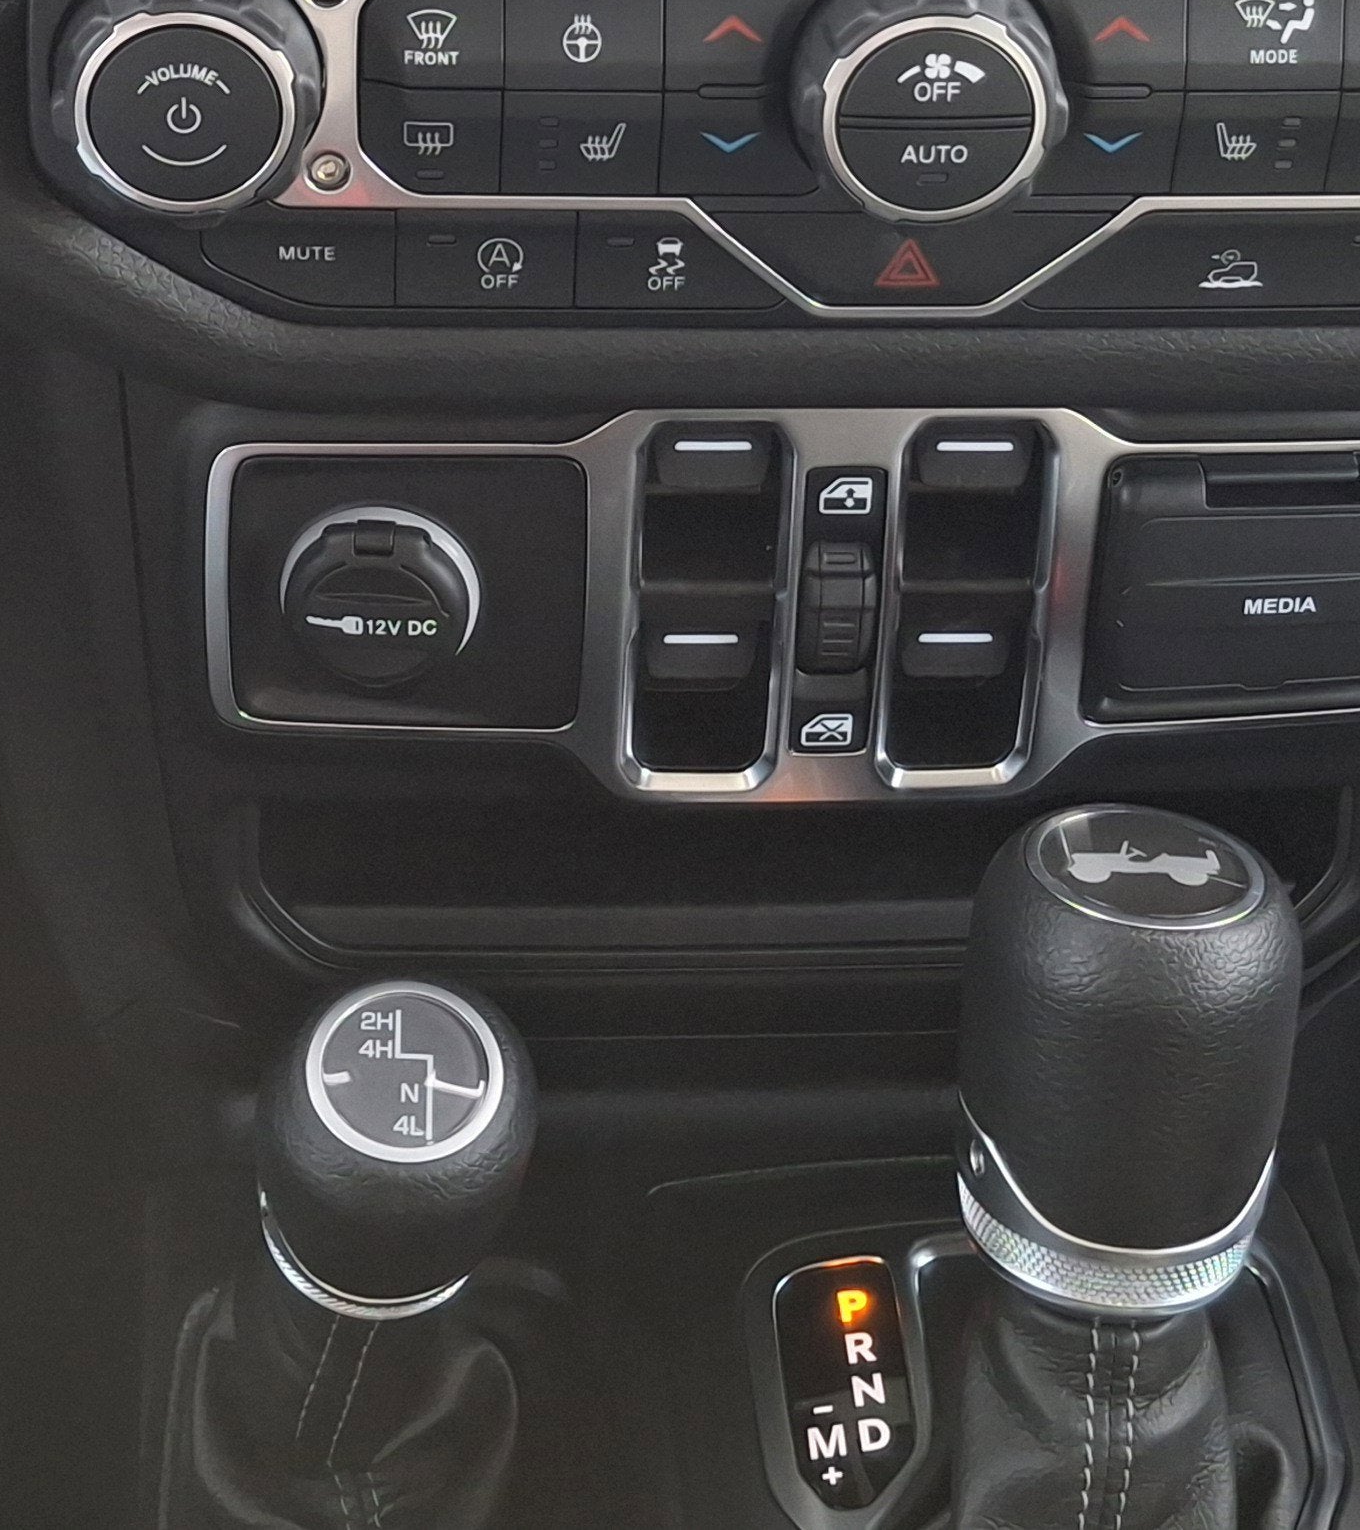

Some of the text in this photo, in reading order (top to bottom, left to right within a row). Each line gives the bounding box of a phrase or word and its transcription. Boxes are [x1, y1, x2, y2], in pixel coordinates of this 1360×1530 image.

[403, 50, 460, 67] FRONT
[1250, 49, 1298, 65] MODE
[145, 62, 220, 87] VOLUME
[913, 81, 962, 102] OFF
[900, 144, 969, 165] AUTO
[278, 245, 336, 262] MUTE
[480, 274, 519, 289] OFF
[647, 276, 686, 291] OFF
[1243, 595, 1317, 616] MEDIA
[365, 618, 438, 637] 12V DC
[359, 1011, 393, 1031] 2H
[358, 1039, 393, 1059] 4H
[400, 1082, 420, 1104] N
[392, 1115, 424, 1136] 4L
[836, 1288, 868, 1323] P
[844, 1331, 877, 1365] R
[851, 1372, 886, 1408] N
[807, 1423, 848, 1460] M
[857, 1418, 891, 1453] D
